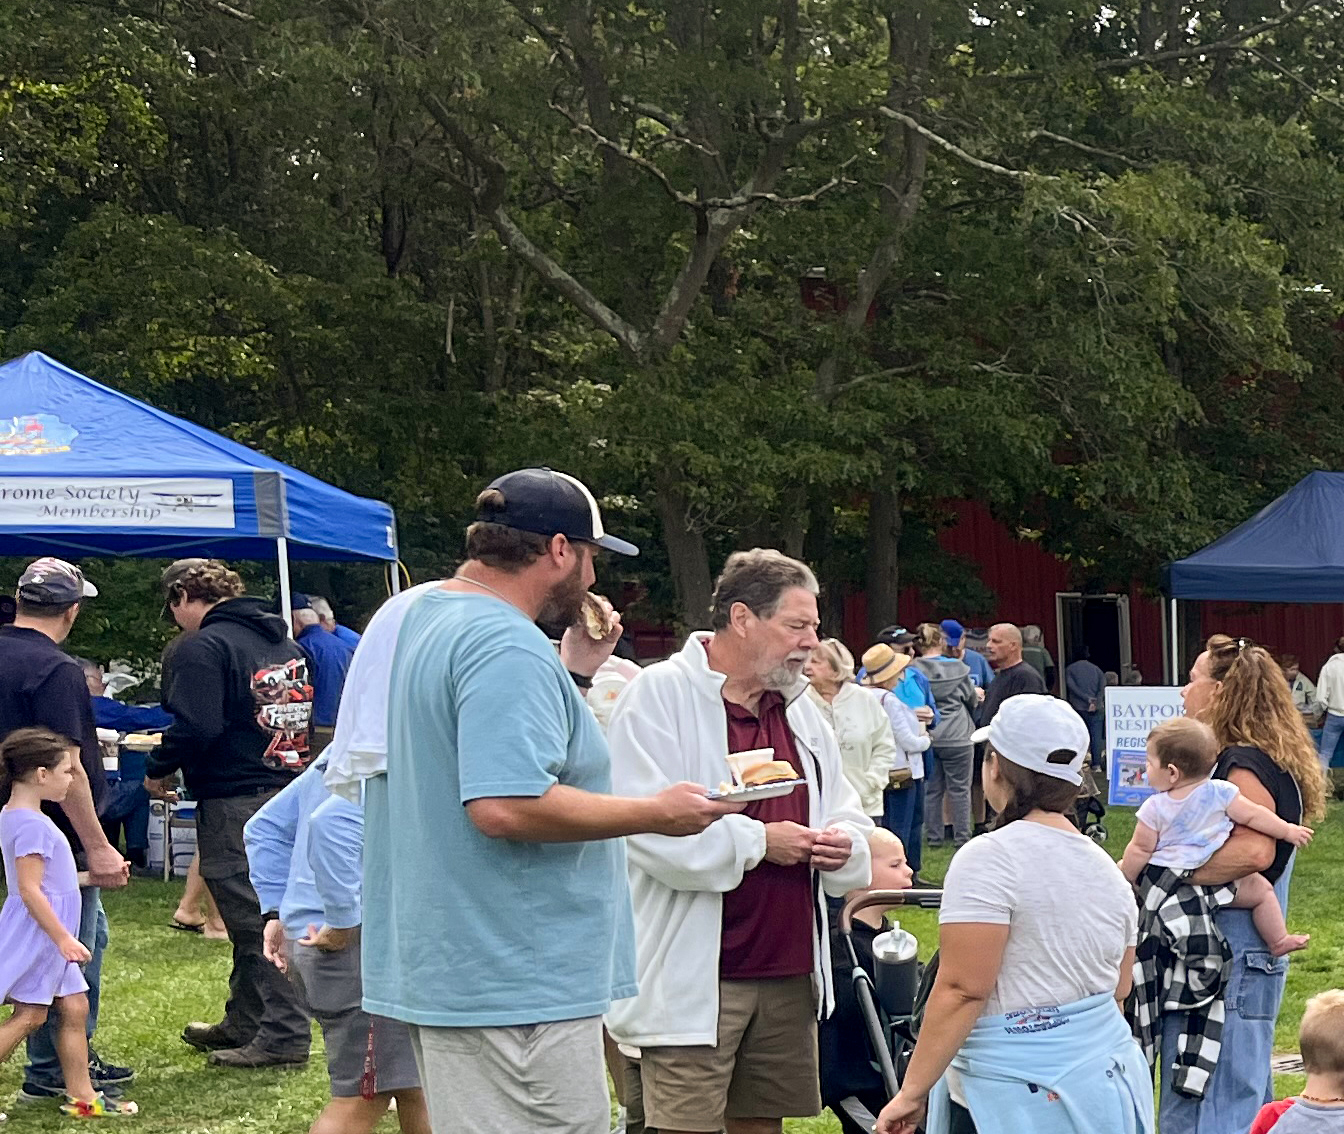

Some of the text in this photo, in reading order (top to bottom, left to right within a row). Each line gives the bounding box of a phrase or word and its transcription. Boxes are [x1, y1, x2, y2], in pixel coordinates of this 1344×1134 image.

[0, 485, 140, 505] rome Society
[37, 503, 161, 522] Membership
